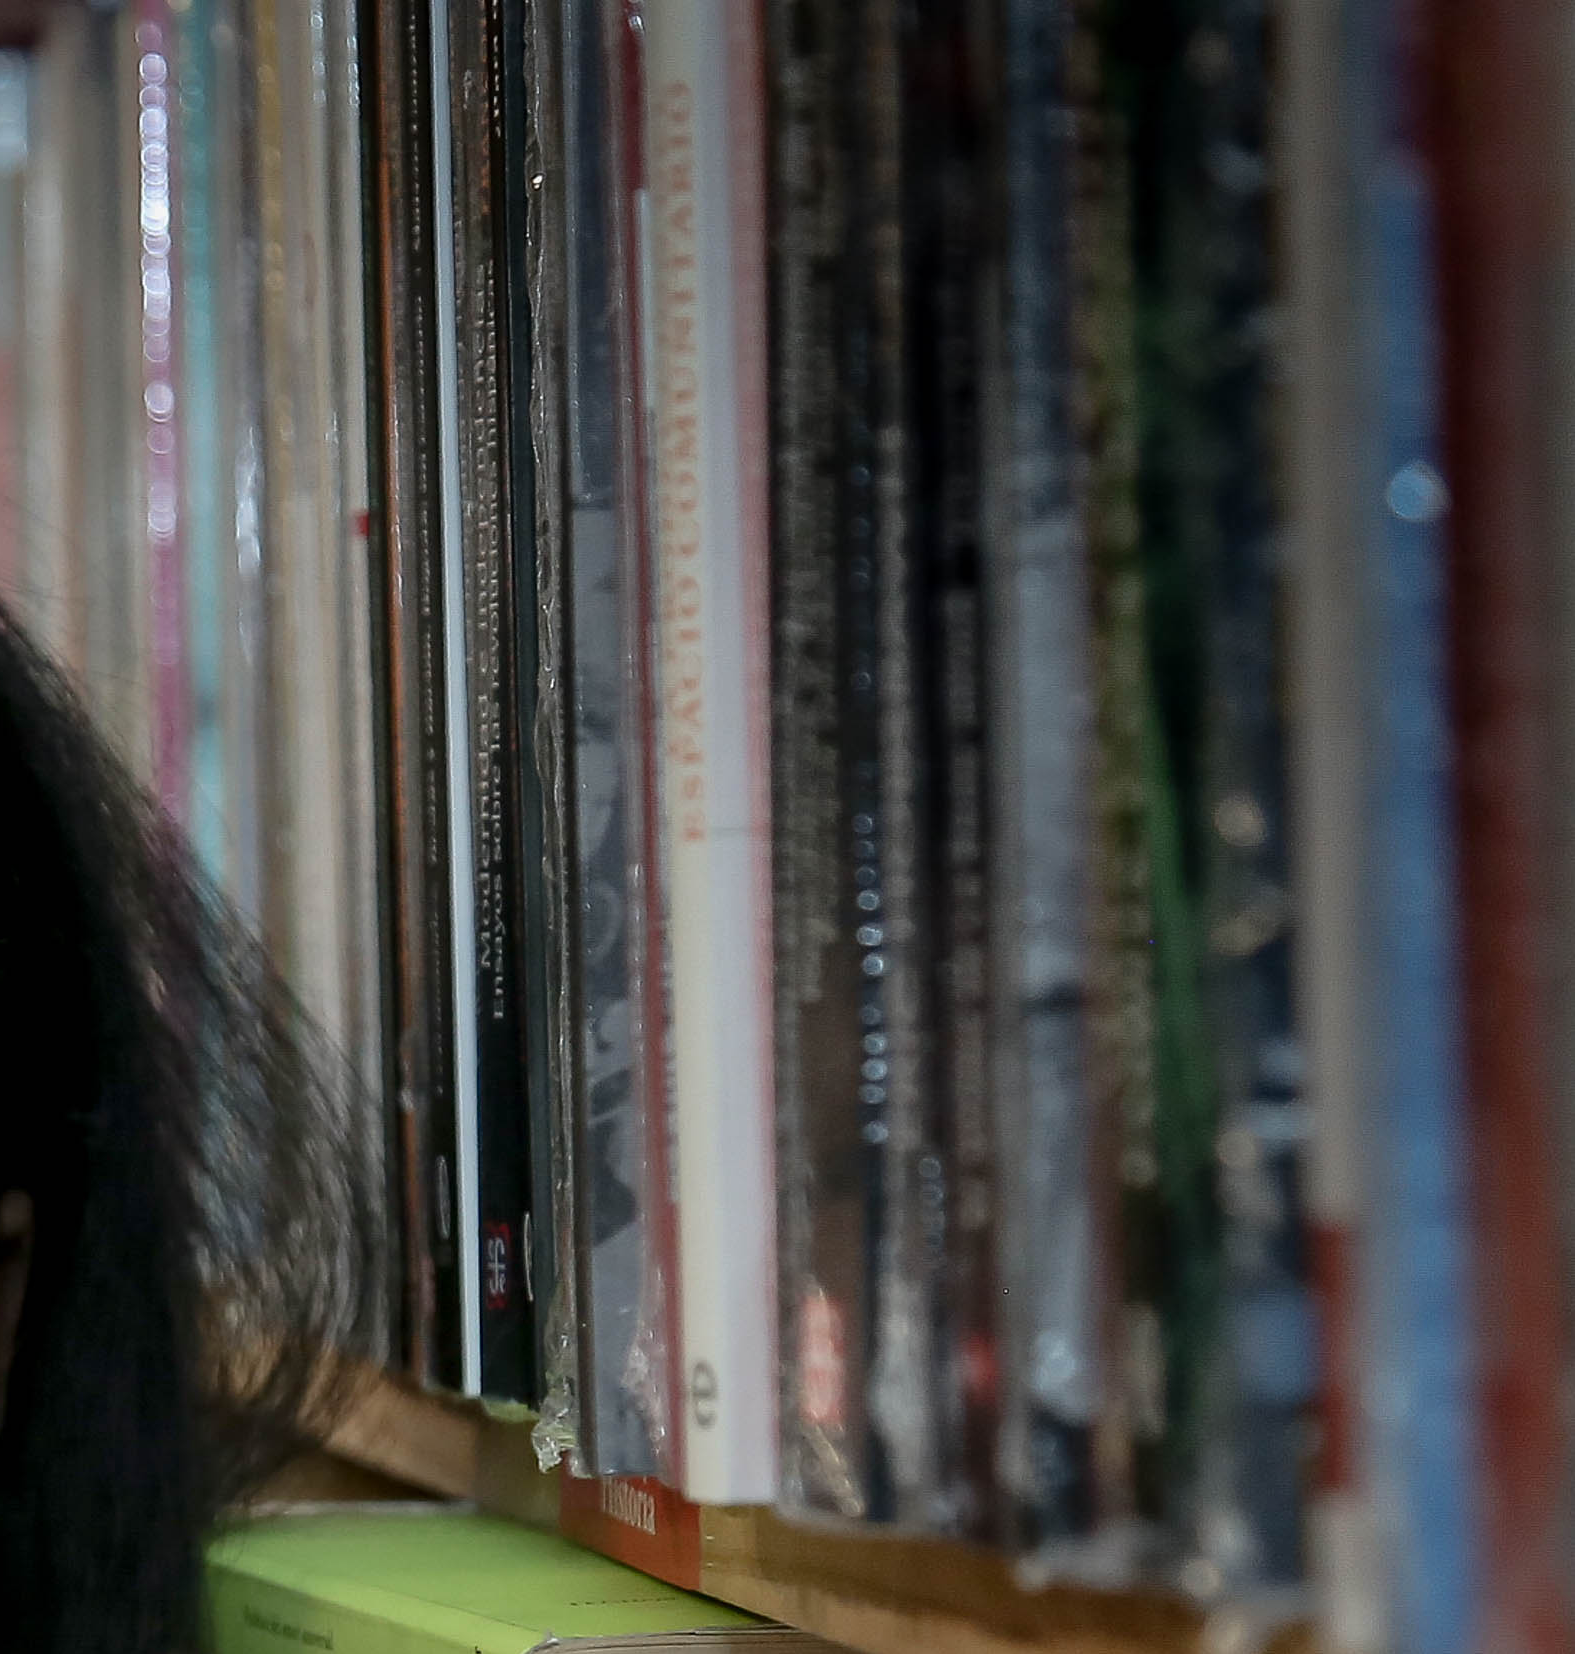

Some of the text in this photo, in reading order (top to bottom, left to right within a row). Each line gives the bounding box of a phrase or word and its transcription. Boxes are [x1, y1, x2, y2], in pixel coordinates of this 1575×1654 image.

[490, 702, 500, 748] las
[477, 694, 492, 968] Modernidad
[491, 766, 502, 862] sobre
[493, 872, 506, 1019] Ensayos
